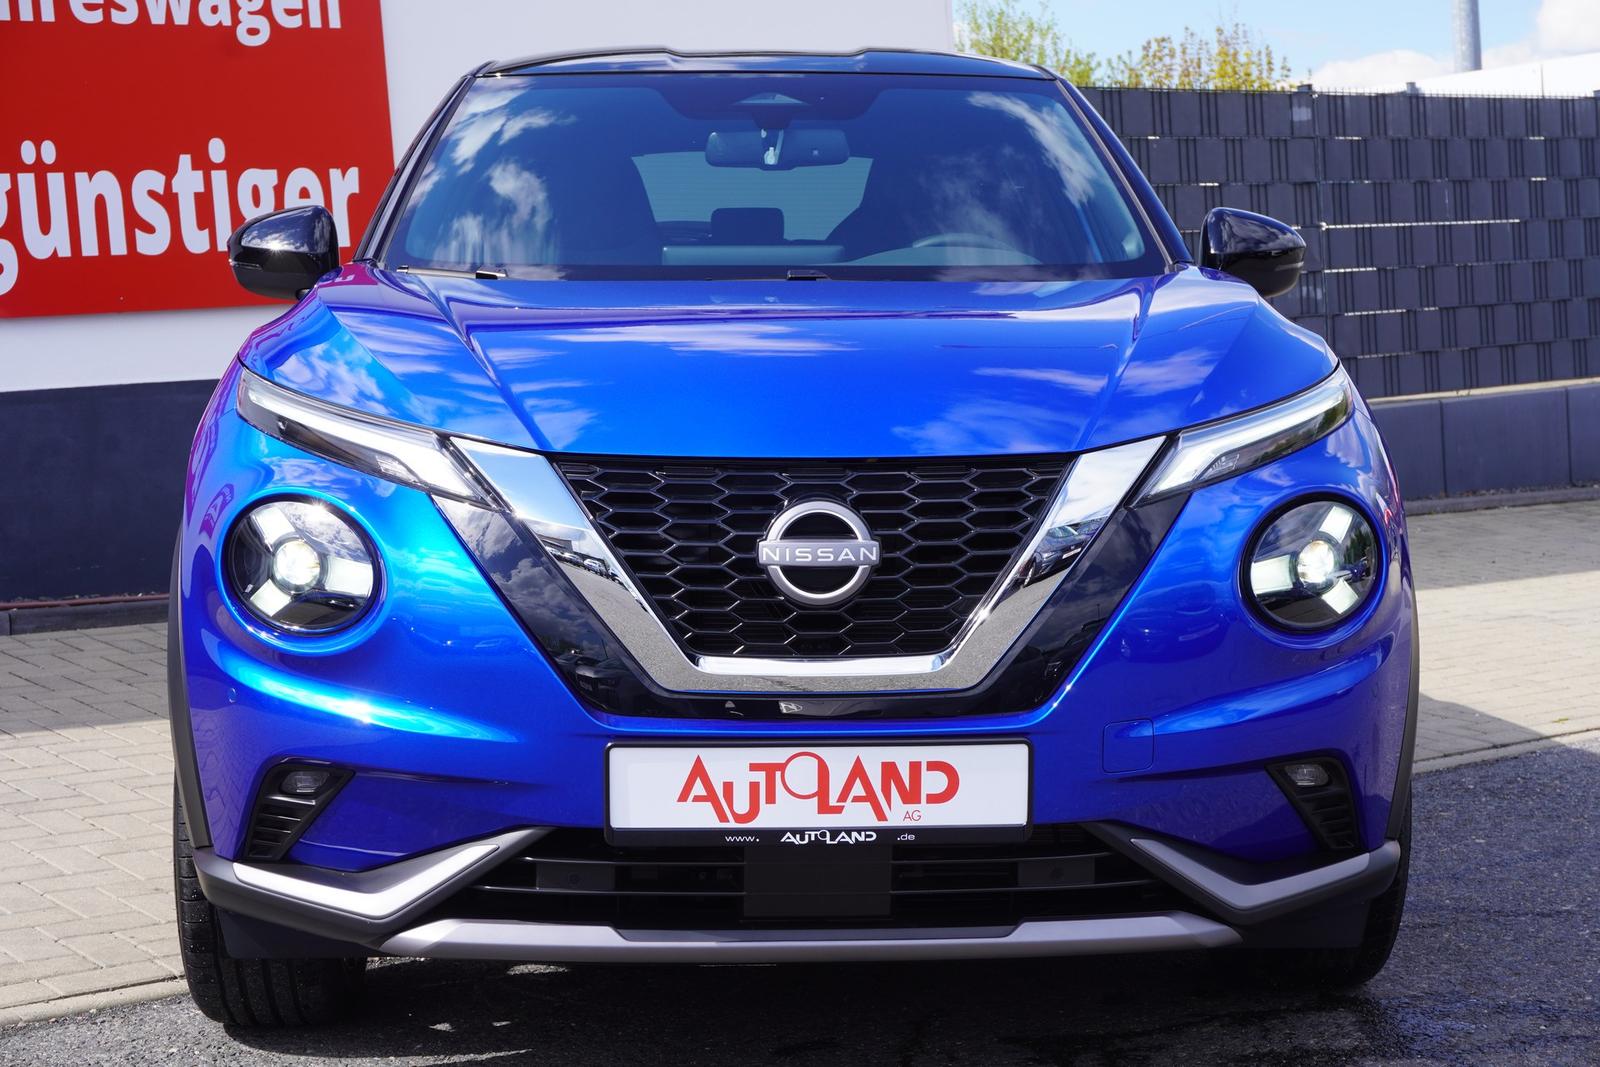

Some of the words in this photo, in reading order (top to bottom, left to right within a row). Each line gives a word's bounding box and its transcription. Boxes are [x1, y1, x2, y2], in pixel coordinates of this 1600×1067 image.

[762, 547, 877, 562] NISSAN
[677, 751, 960, 824] AUTOLAND
[903, 809, 923, 823] AG
[725, 834, 760, 842] www.
[780, 829, 877, 845] AUTOLAND
[897, 832, 916, 841] .de
